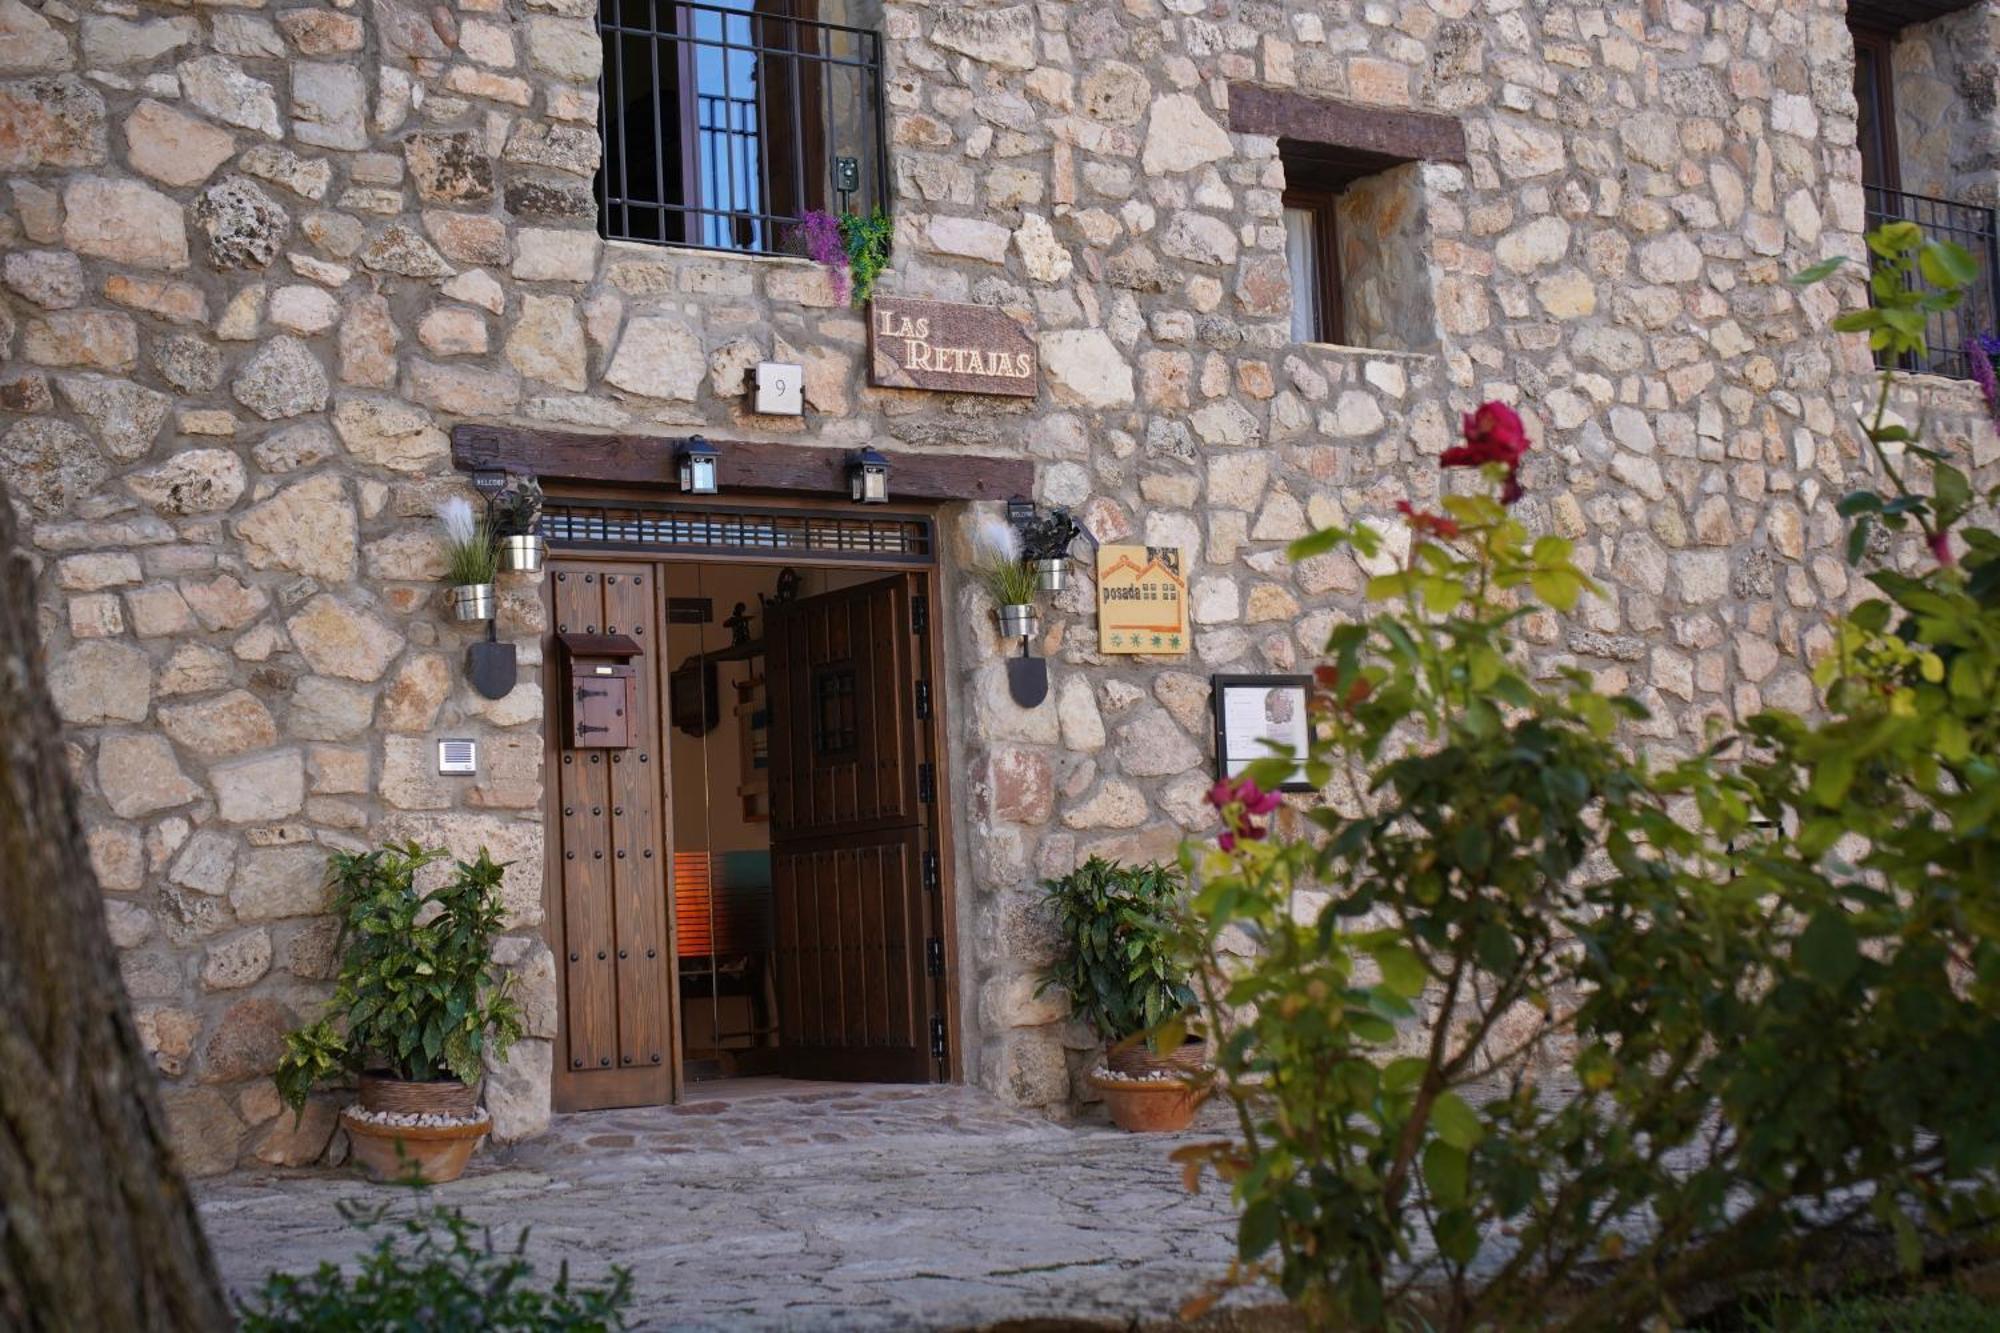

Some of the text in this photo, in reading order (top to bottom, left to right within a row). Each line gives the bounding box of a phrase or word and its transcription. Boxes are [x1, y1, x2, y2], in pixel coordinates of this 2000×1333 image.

[880, 311, 930, 338] LAS
[904, 339, 1030, 378] RETAJAS
[775, 379, 786, 397] 9
[1103, 583, 1141, 605] posada
